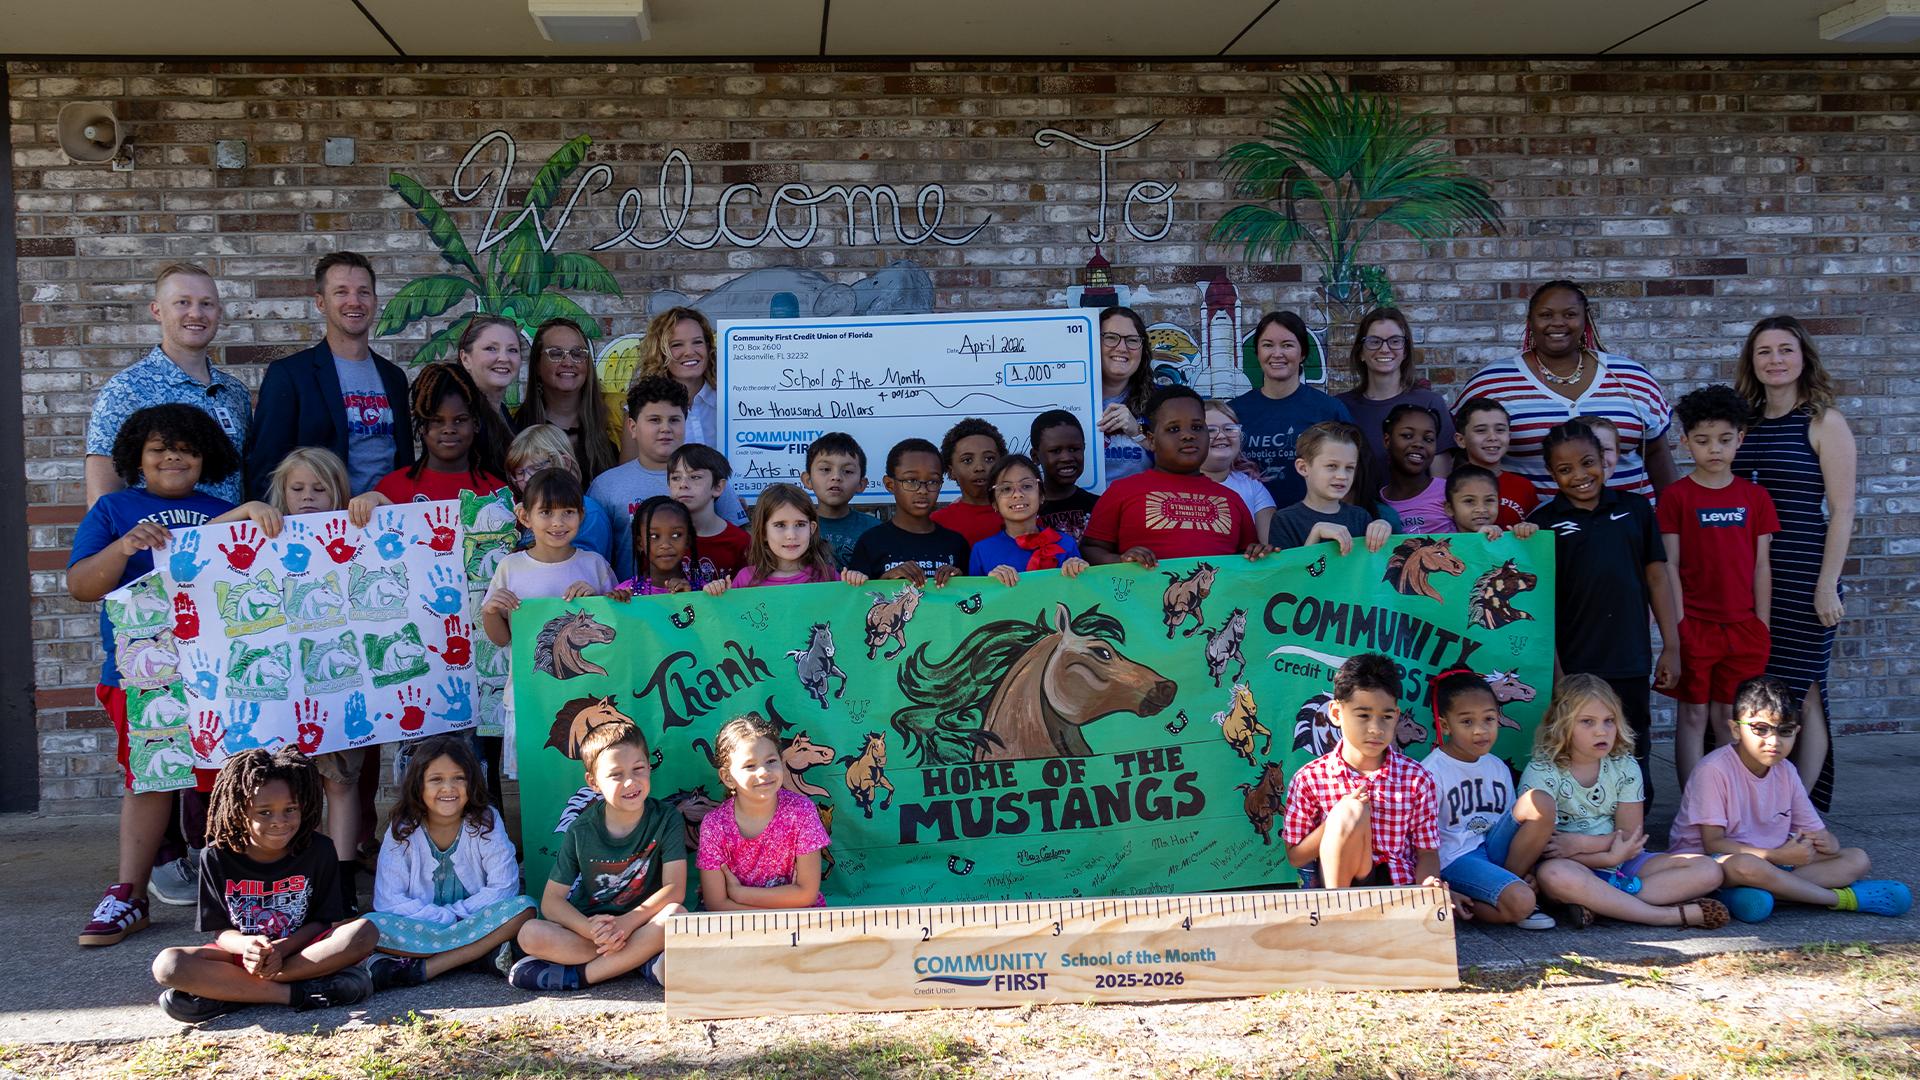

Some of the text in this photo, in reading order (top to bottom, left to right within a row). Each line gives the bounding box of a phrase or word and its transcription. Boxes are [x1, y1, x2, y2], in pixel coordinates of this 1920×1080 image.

[452, 119, 1178, 255] Welcome To
[732, 334, 774, 342] Community
[775, 333, 792, 341] First
[817, 332, 838, 340] Union
[848, 331, 873, 339] Florida
[1066, 325, 1083, 333] 101
[762, 343, 781, 351] 2600
[959, 334, 995, 363] April
[1001, 336, 1025, 353] 2026
[733, 353, 775, 361] Jacksonville,
[786, 352, 809, 360] 32232
[779, 368, 825, 388] School
[831, 368, 845, 389] of
[849, 370, 874, 390] the
[879, 367, 926, 386] Month
[738, 400, 875, 418] One thousand Dollars
[736, 430, 824, 443] COMMUNITY
[744, 459, 781, 478] Arts
[351, 608, 407, 619] MUSTANGS
[227, 616, 287, 638] MUSTANGS
[288, 615, 346, 633] MUSTANGS
[1263, 592, 1483, 667] COMMUNITY
[227, 688, 288, 698] MUSTANGS
[306, 677, 363, 694] MUSTANGS
[632, 640, 777, 734] Thank
[921, 746, 1185, 798] HOME OF THE
[135, 777, 196, 790] MUSTANGS
[898, 771, 1206, 845] MUSTANGS
[1447, 778, 1506, 827] POLO
[225, 875, 305, 896] MILES
[1181, 916, 1191, 931] 4
[1309, 912, 1319, 926] 5
[1436, 907, 1446, 922] 6
[921, 927, 931, 942] 2
[1052, 922, 1061, 936] 3
[790, 932, 799, 947] 1
[914, 952, 1048, 975] COMMUNITY
[1061, 947, 1216, 968] School of the Month
[995, 973, 1049, 992] FIRST
[1095, 971, 1185, 989] 2025-2026
[914, 986, 956, 996] Credit Union
